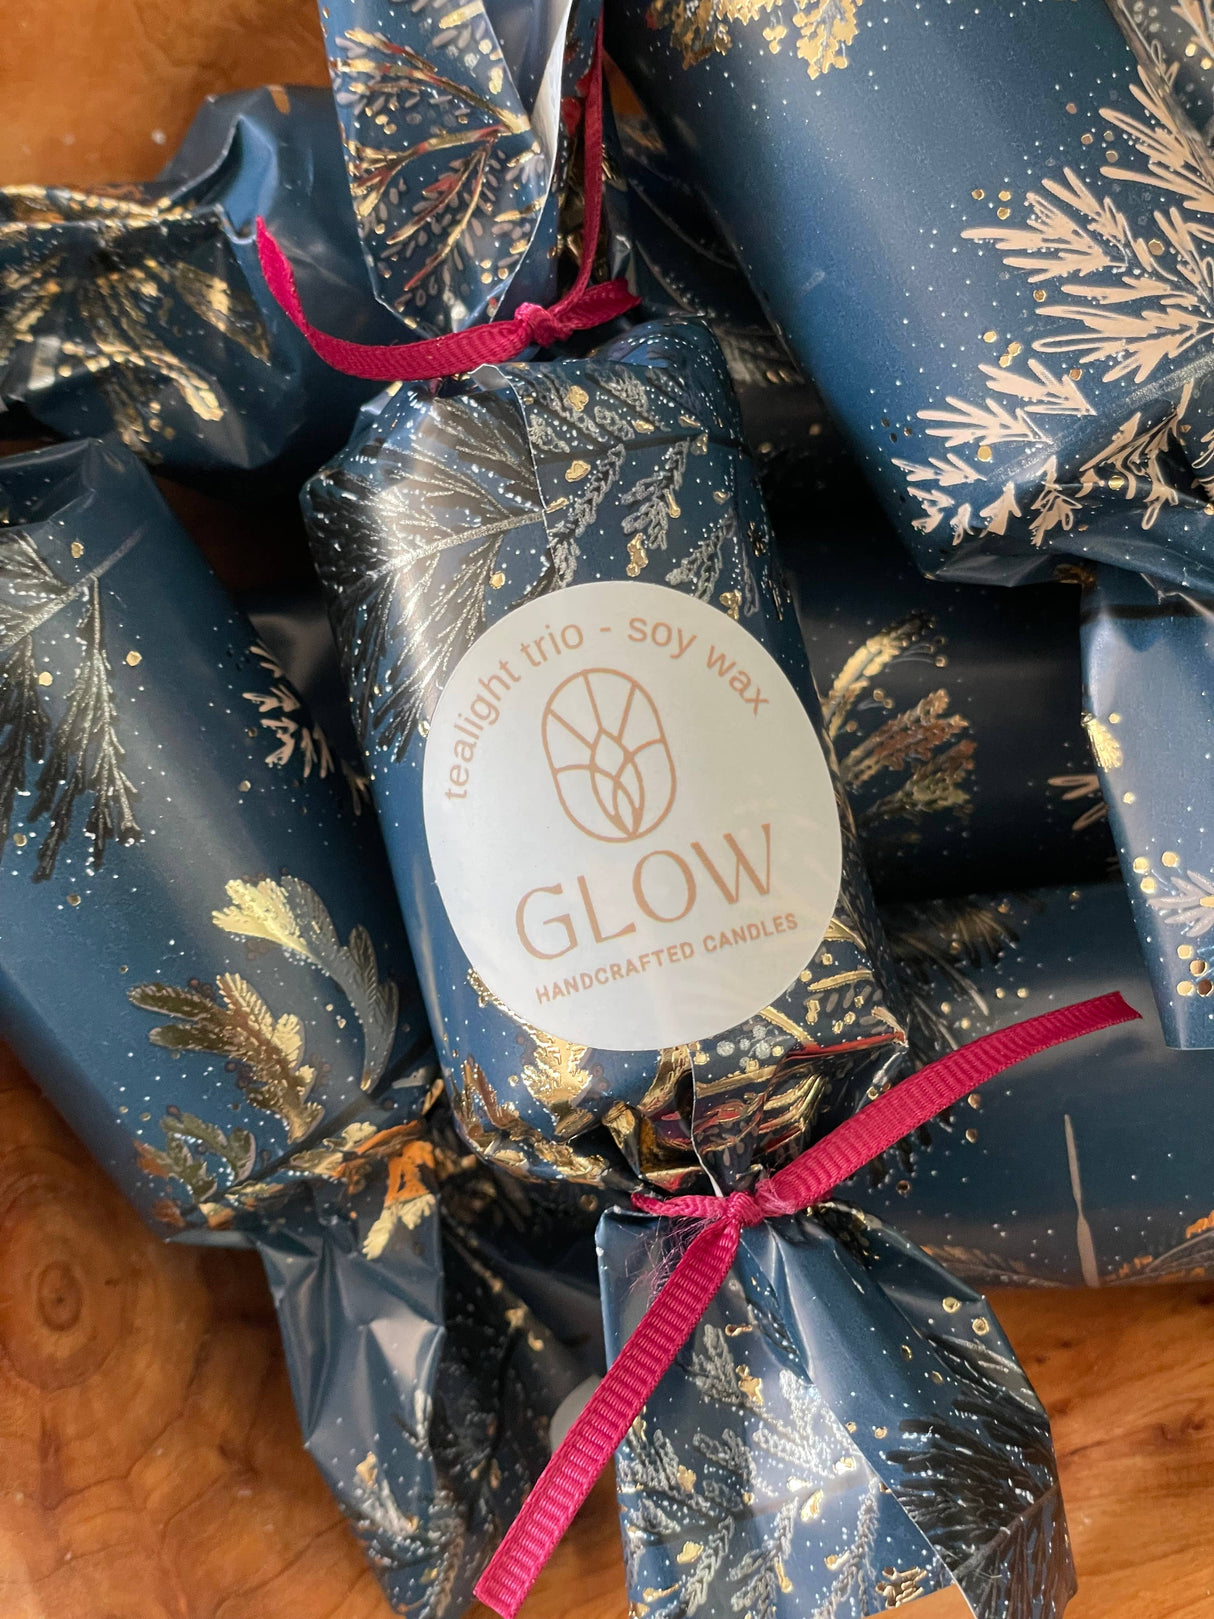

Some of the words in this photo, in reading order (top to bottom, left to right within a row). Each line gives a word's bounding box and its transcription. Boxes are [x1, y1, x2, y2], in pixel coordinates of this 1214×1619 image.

[445, 659, 521, 801] tealight
[520, 623, 584, 668] trio
[627, 617, 697, 660] soy
[705, 645, 769, 716] wax
[515, 823, 771, 960] GLOW
[535, 942, 695, 1004] HANDCRAFTED
[703, 912, 799, 953] CANDLES
